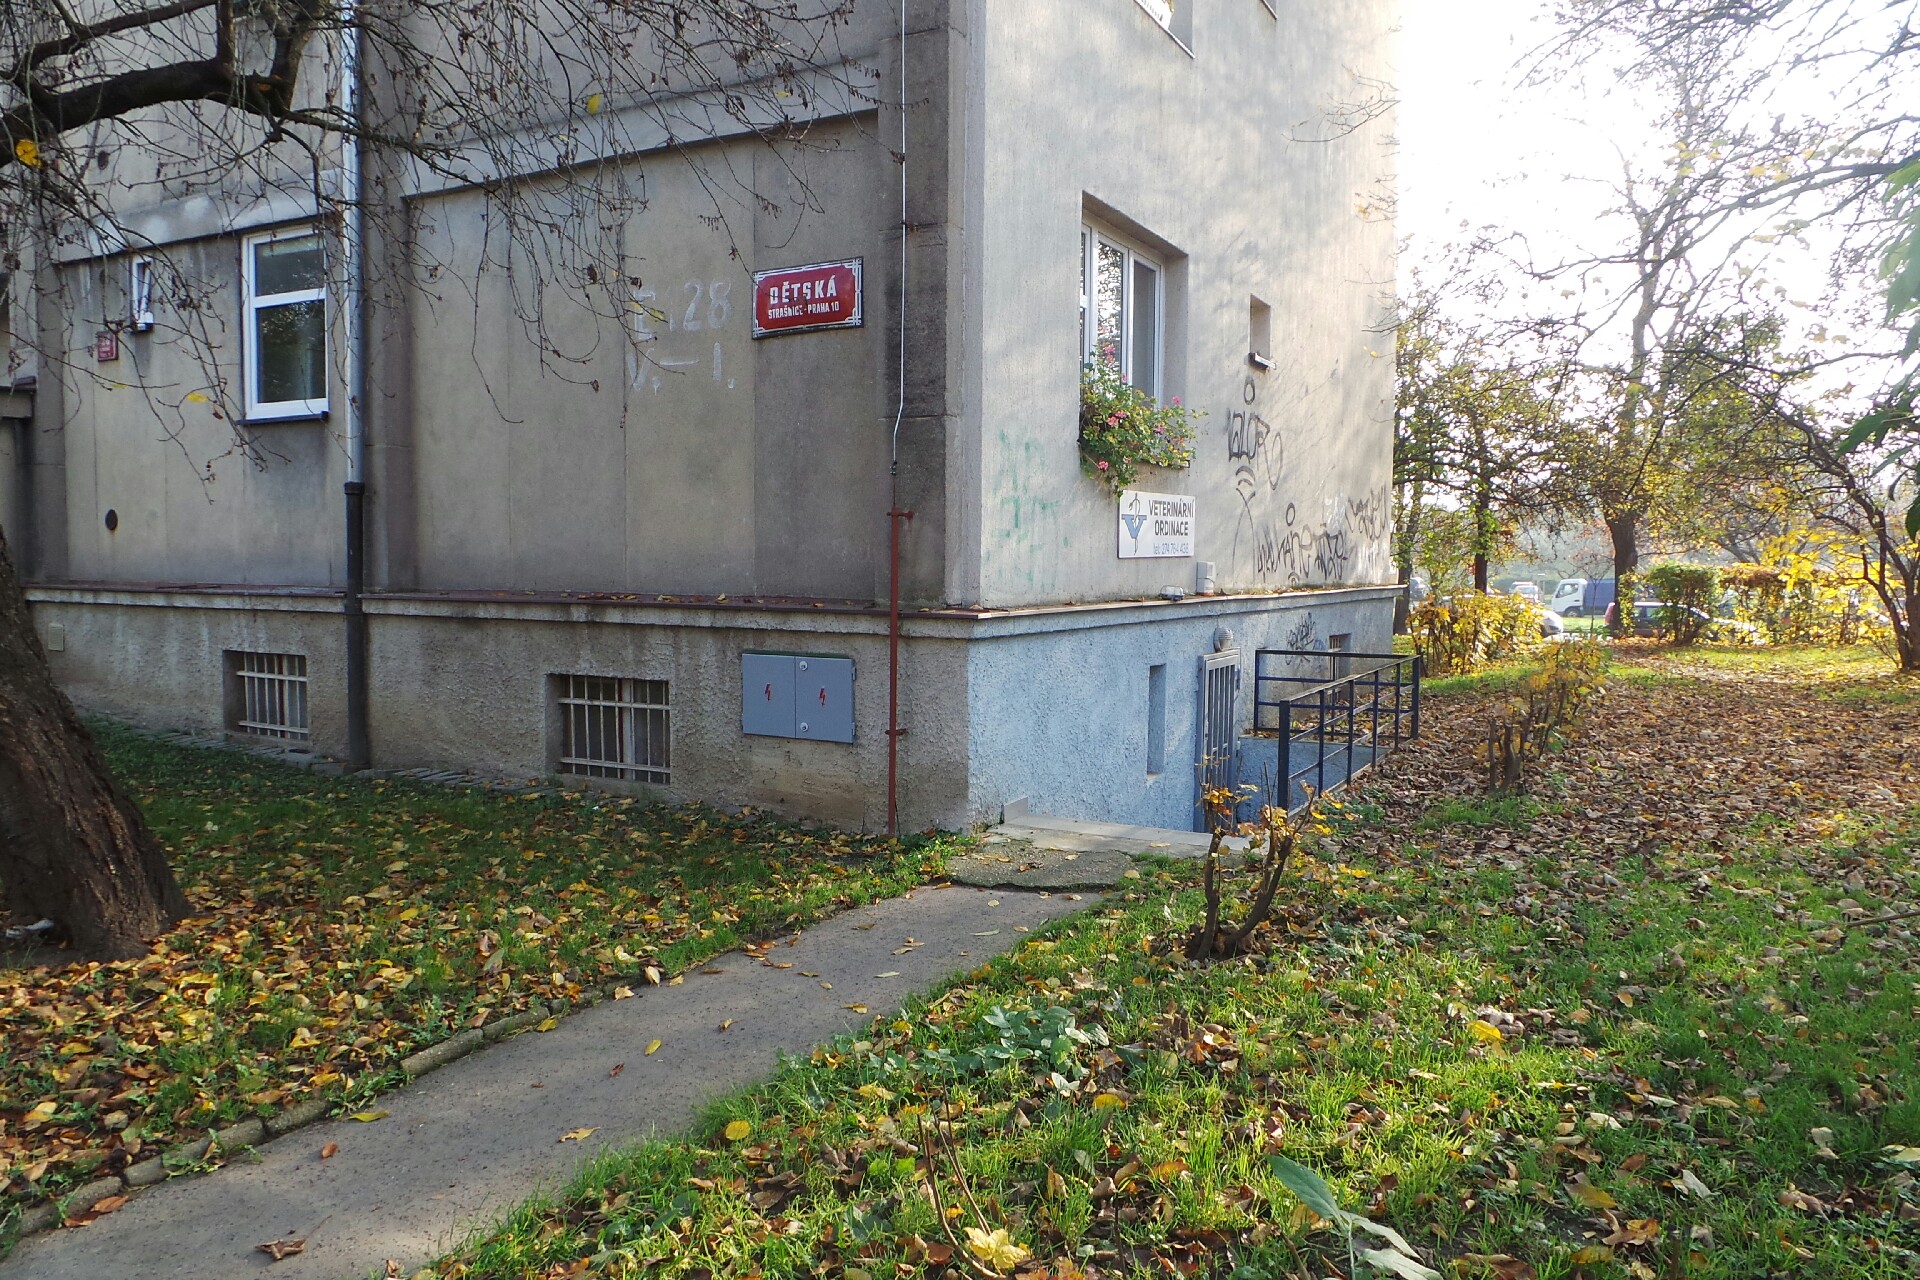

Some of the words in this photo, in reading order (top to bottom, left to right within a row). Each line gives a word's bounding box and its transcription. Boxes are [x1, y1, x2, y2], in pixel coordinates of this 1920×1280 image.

[769, 275, 837, 305] DĚTSKÁ
[768, 304, 804, 319] STRAŠNICE
[807, 303, 830, 315] PRAHA
[831, 301, 840, 312] 10
[1148, 498, 1195, 518] VETERINÁRNÍ
[1154, 519, 1189, 536] ORDINACE
